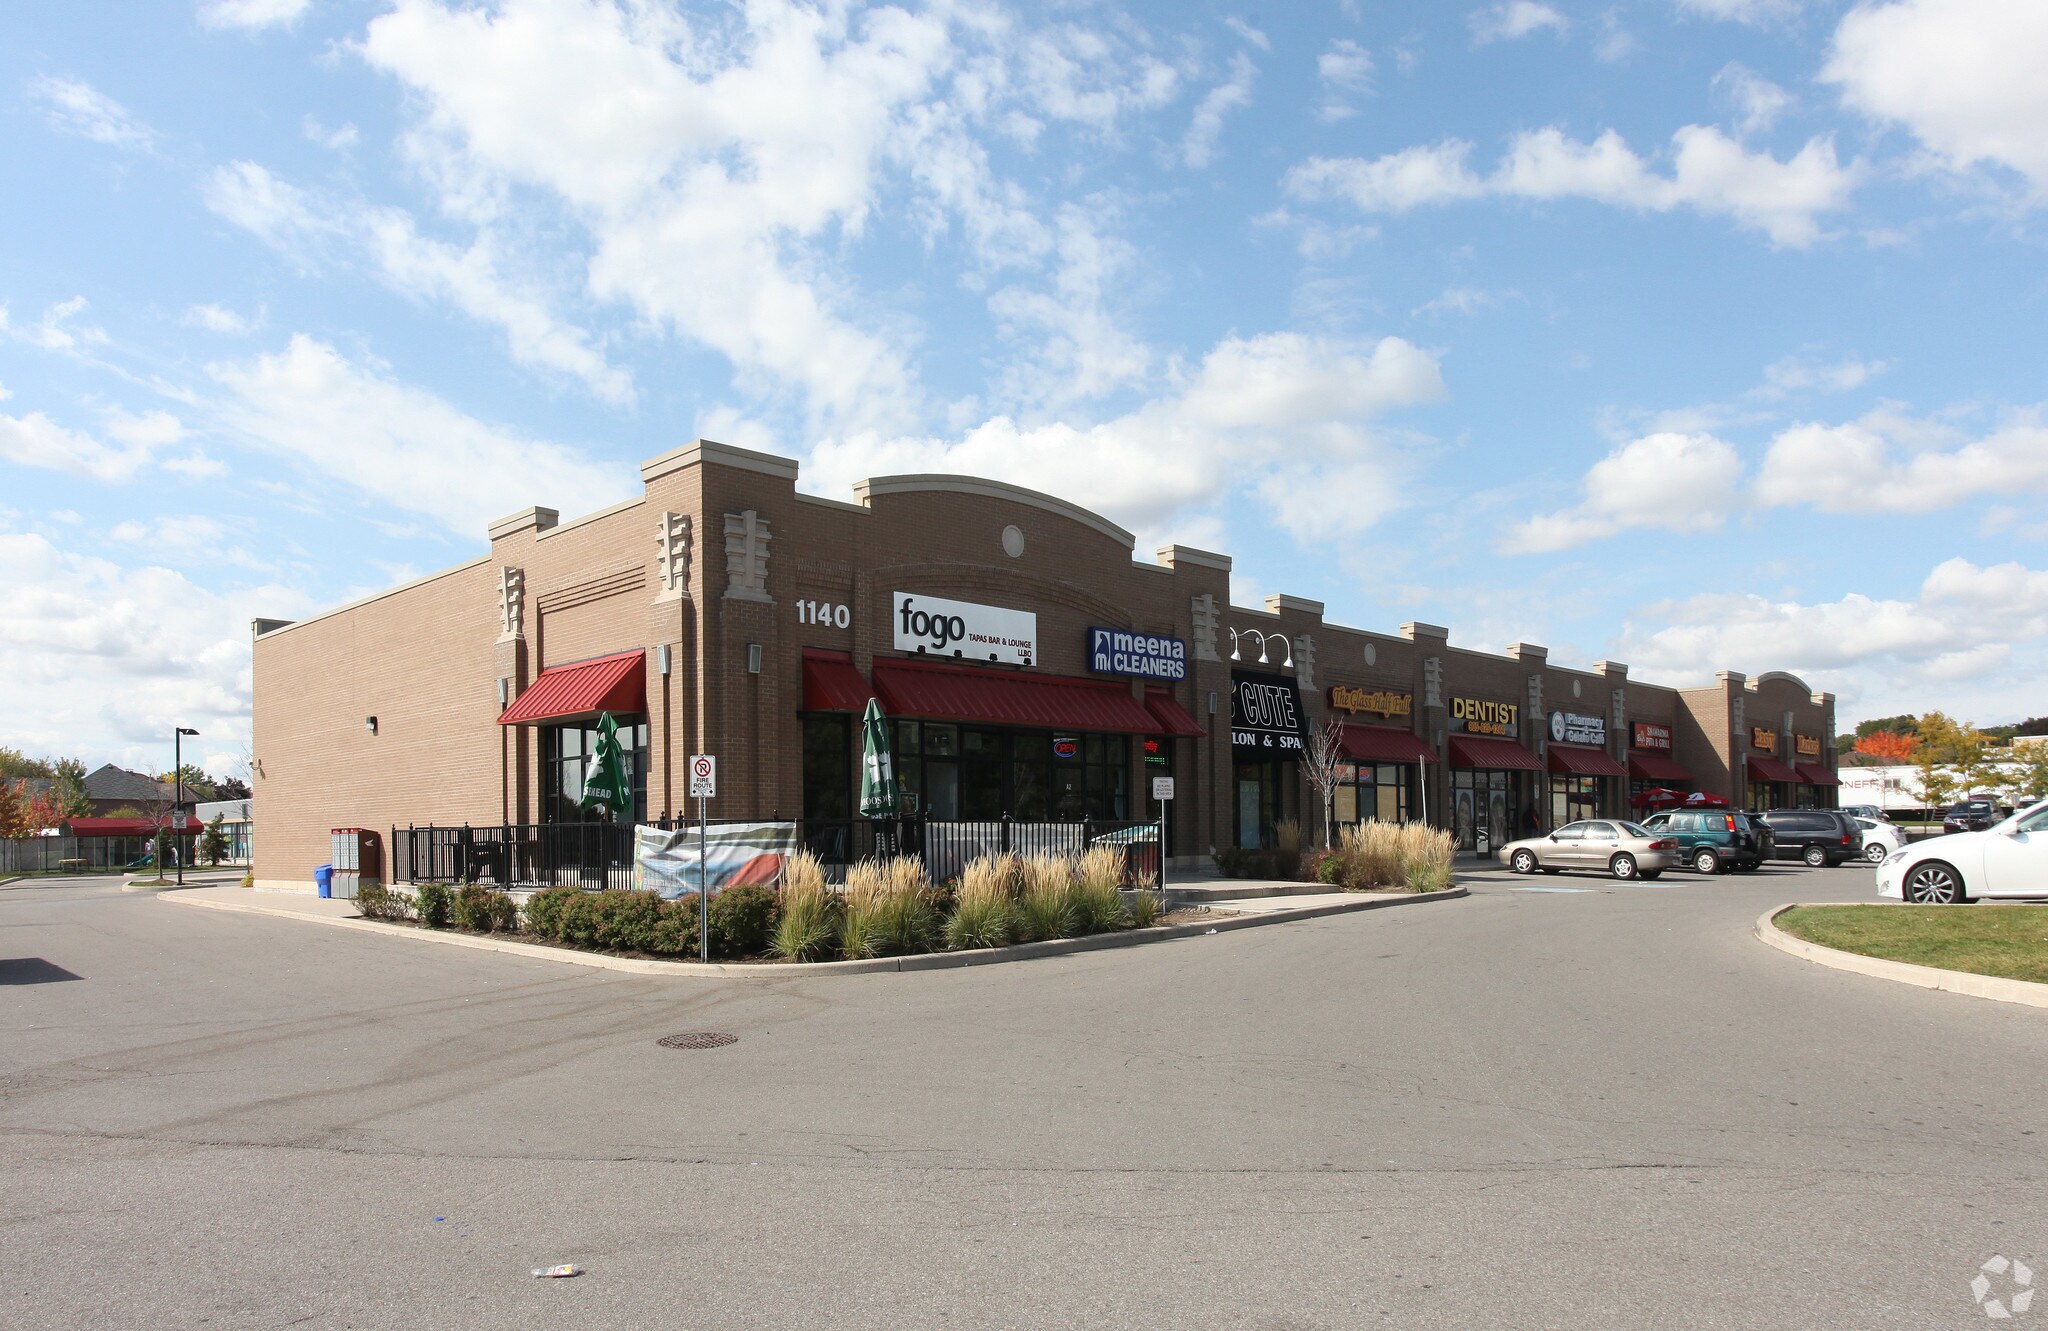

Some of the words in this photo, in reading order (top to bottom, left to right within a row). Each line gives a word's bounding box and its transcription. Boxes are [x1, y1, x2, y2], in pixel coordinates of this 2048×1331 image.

[796, 599, 850, 629] 1140
[900, 598, 966, 650] fogo
[968, 633, 987, 644] TAPAS
[988, 635, 1000, 645] BAR
[1002, 637, 1007, 646] &
[1008, 638, 1032, 648] LOUNGE
[1113, 633, 1184, 659] meena
[1017, 649, 1032, 658] LLBO
[1114, 653, 1185, 679] CLEANERS
[1240, 682, 1297, 728] CUTE
[1334, 687, 1348, 706] The
[1350, 690, 1371, 712] Glass
[1372, 693, 1393, 716] Half
[1453, 698, 1517, 724] DENTIST
[1568, 713, 1604, 729] Pharmacy
[1231, 732, 1256, 746] LON
[1263, 734, 1273, 747] &
[1279, 736, 1302, 749] SPA
[1568, 730, 1590, 743] Gelato
[1056, 743, 1077, 753] OPEN
[1841, 779, 1878, 789] NEFF
